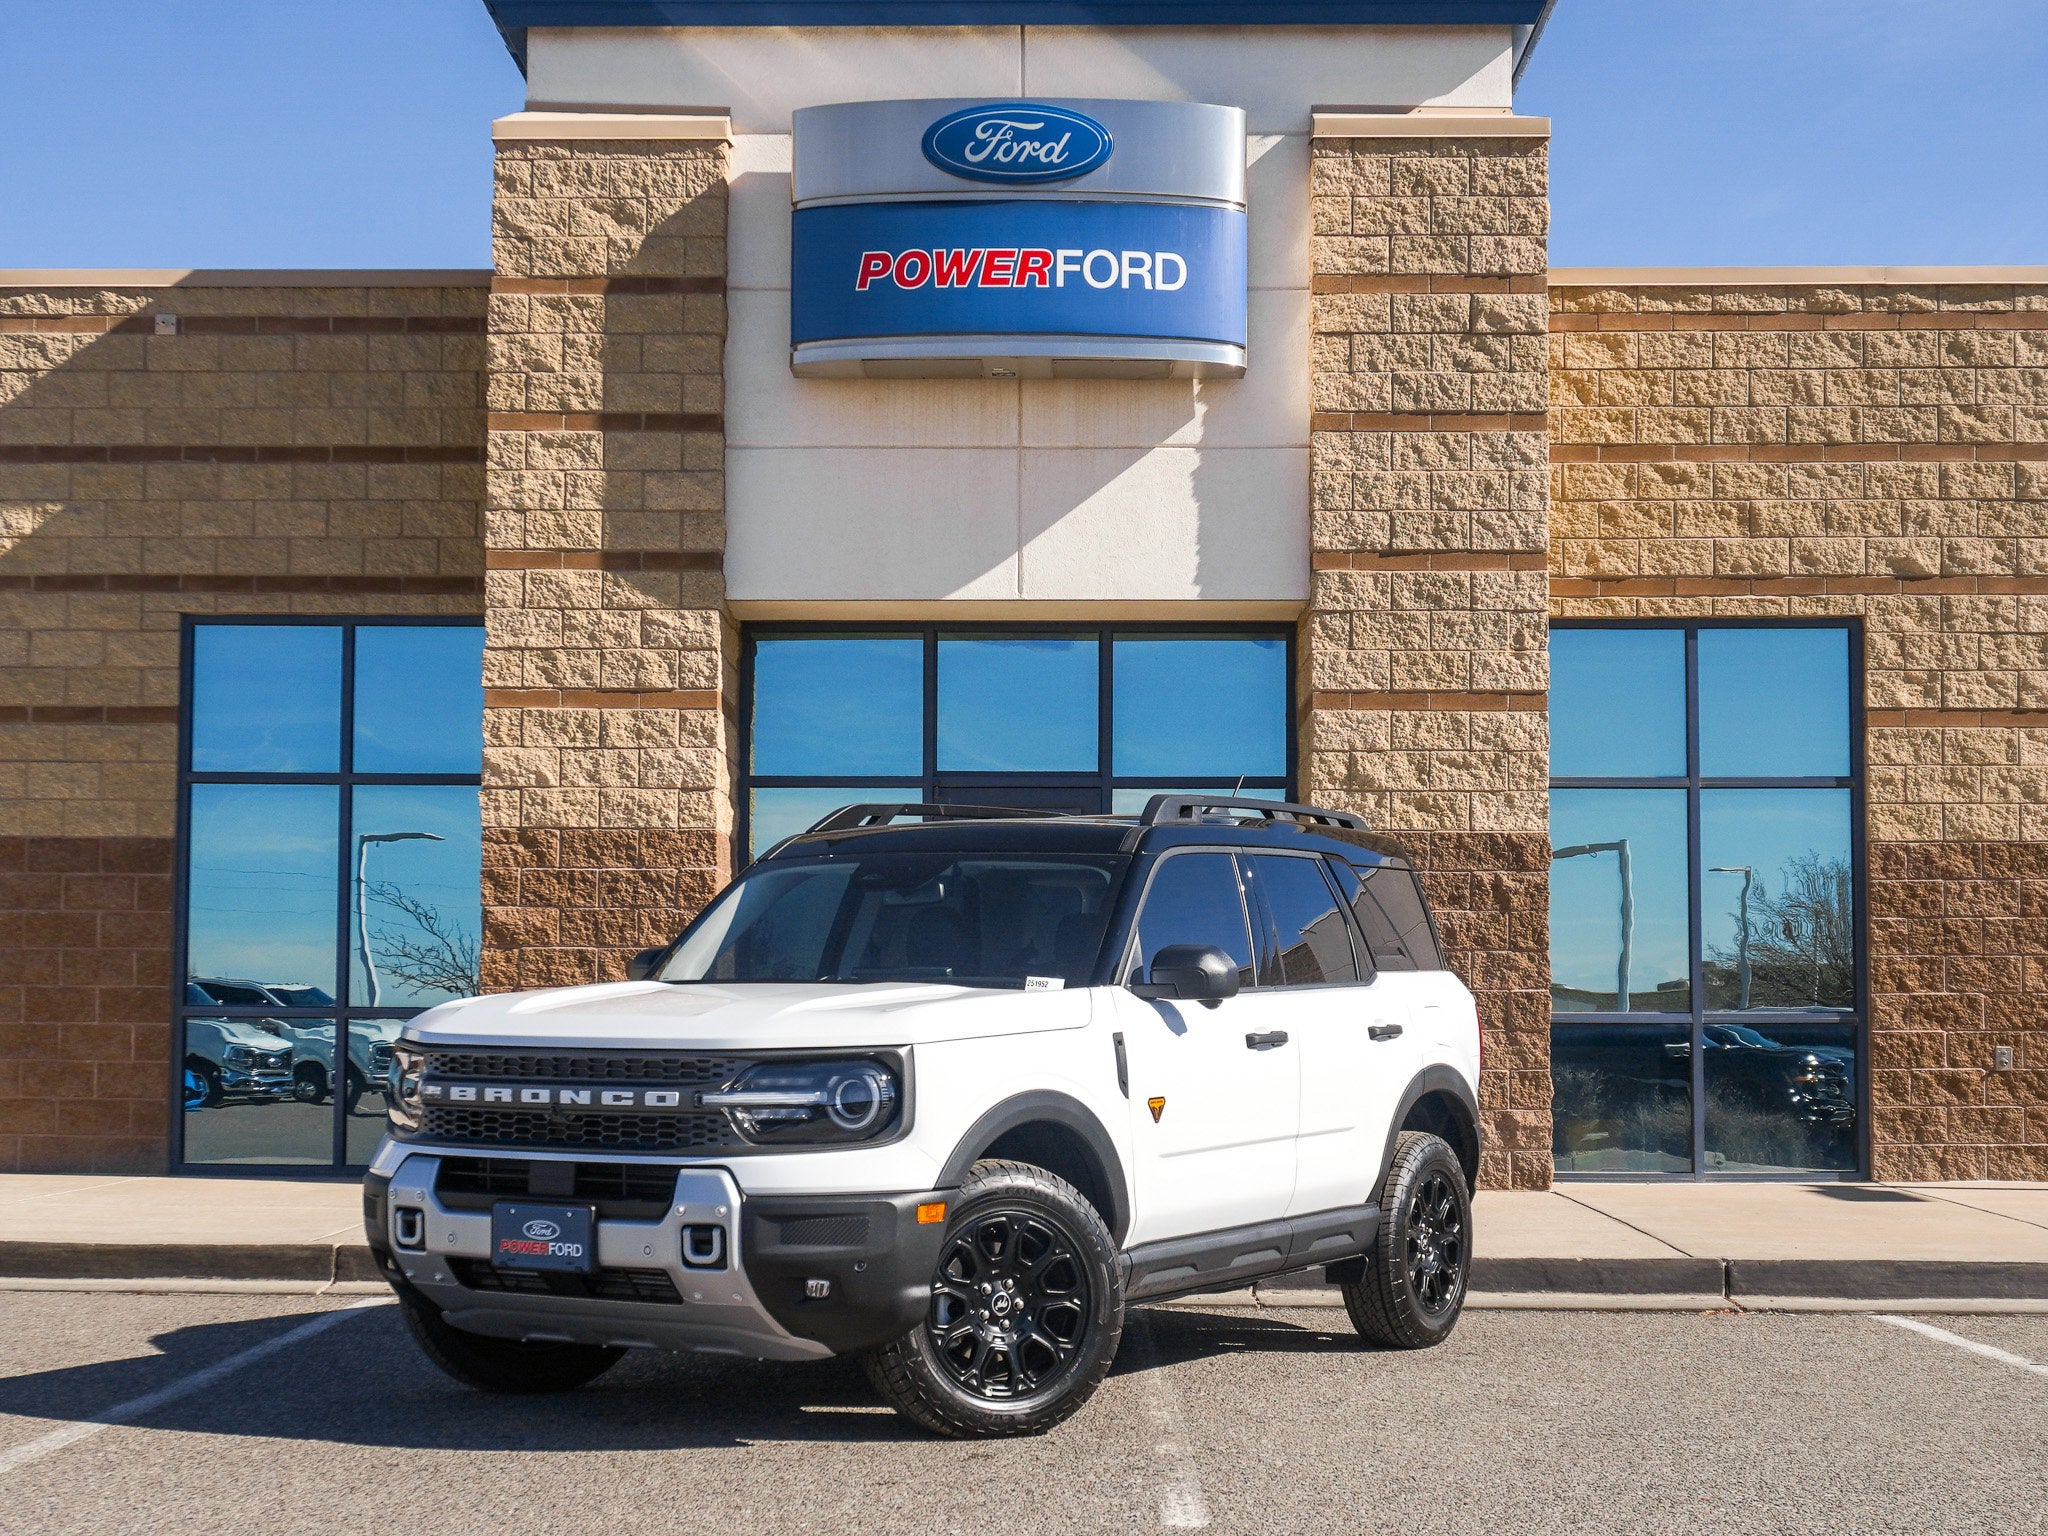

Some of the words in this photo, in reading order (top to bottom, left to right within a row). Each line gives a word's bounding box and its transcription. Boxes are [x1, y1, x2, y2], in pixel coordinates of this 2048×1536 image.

[965, 119, 1072, 164] Ford
[855, 248, 1188, 292] POWERFORD
[1027, 979, 1049, 988] 251952
[450, 1086, 680, 1107] BRONCO
[529, 1223, 553, 1237] Ford
[499, 1239, 582, 1257] POWERFORD
